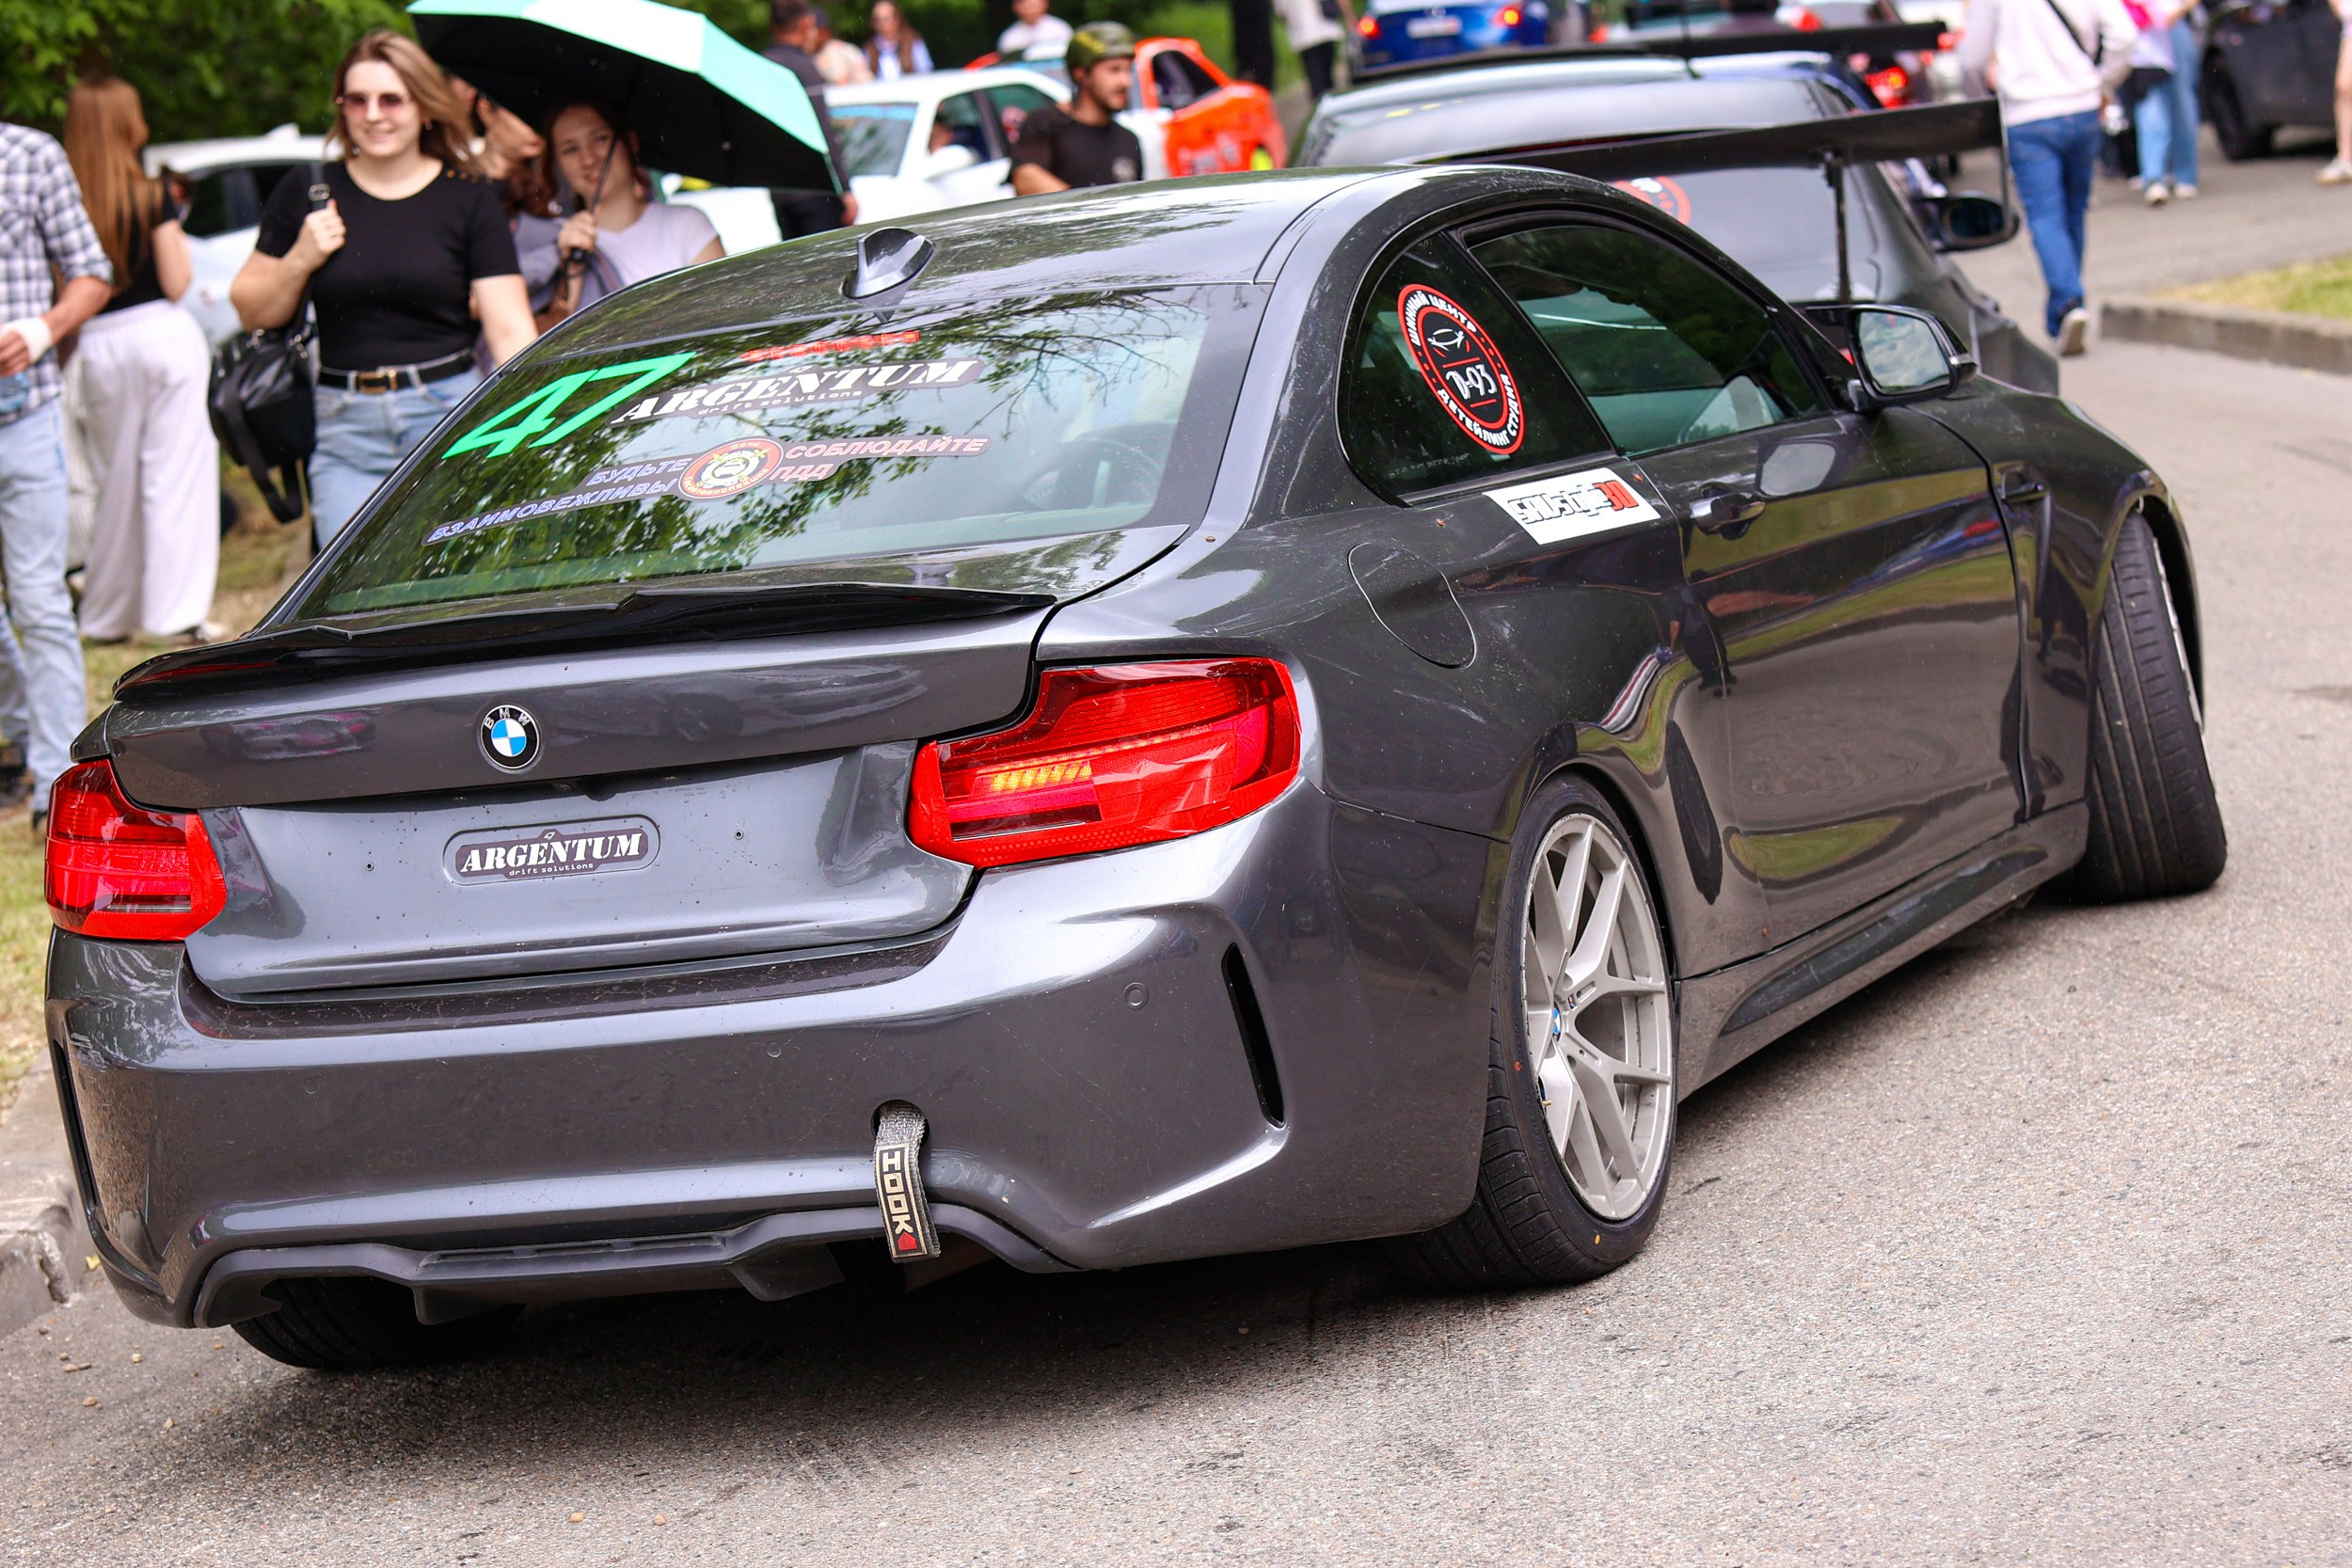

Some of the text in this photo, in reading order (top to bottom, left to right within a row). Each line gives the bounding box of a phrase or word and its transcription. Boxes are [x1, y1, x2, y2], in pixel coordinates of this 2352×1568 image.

[1405, 291, 1477, 347] ШИННЫЙ ЦЕНТР
[441, 352, 697, 460] 47
[610, 360, 978, 424] ARGENTUM
[698, 390, 863, 416] drift solutions
[1437, 373, 1519, 446] ДЕТЕЙЛИНГ СТУДИЯ
[785, 436, 989, 459] СОБЛЮДАЙТЕ
[585, 457, 693, 486] БУДЬТЕ
[769, 463, 834, 482] ПДД
[426, 478, 678, 543] ВЗАИМОВЕЖЛИВЫ
[484, 707, 531, 730] BMW
[460, 832, 643, 873] ARGENTUM
[509, 863, 594, 877] drift solutions
[882, 1150, 914, 1235] HOOK
